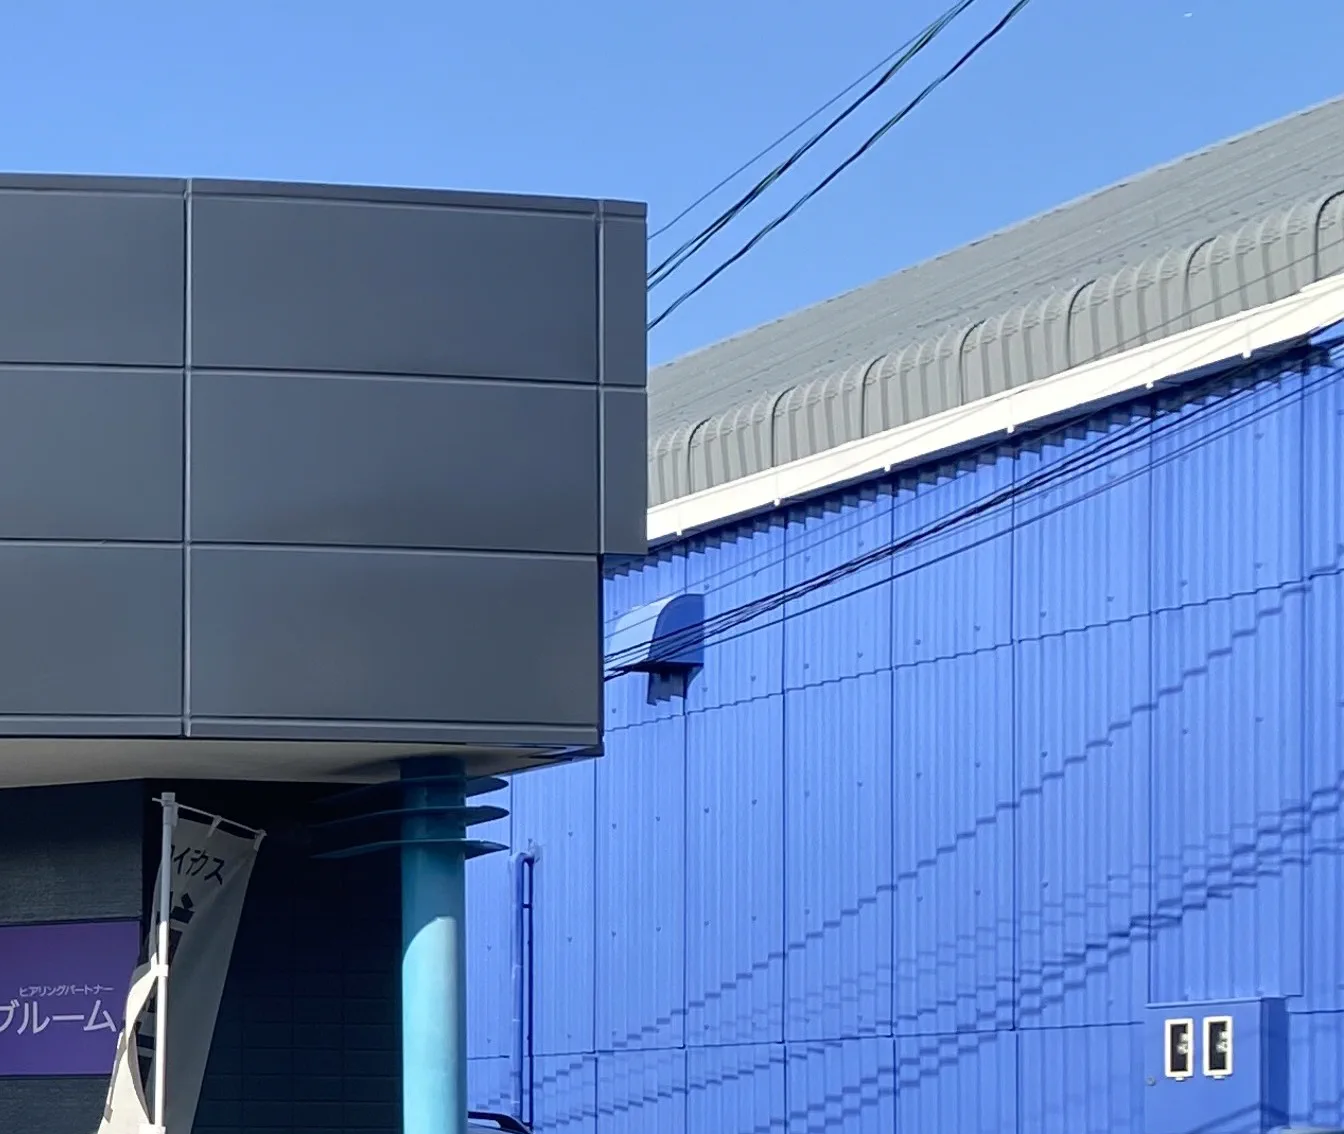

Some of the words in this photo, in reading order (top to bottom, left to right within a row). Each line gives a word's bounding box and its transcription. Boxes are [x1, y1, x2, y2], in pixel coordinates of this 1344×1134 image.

[19, 984, 114, 997] ヒアリングパートナー
